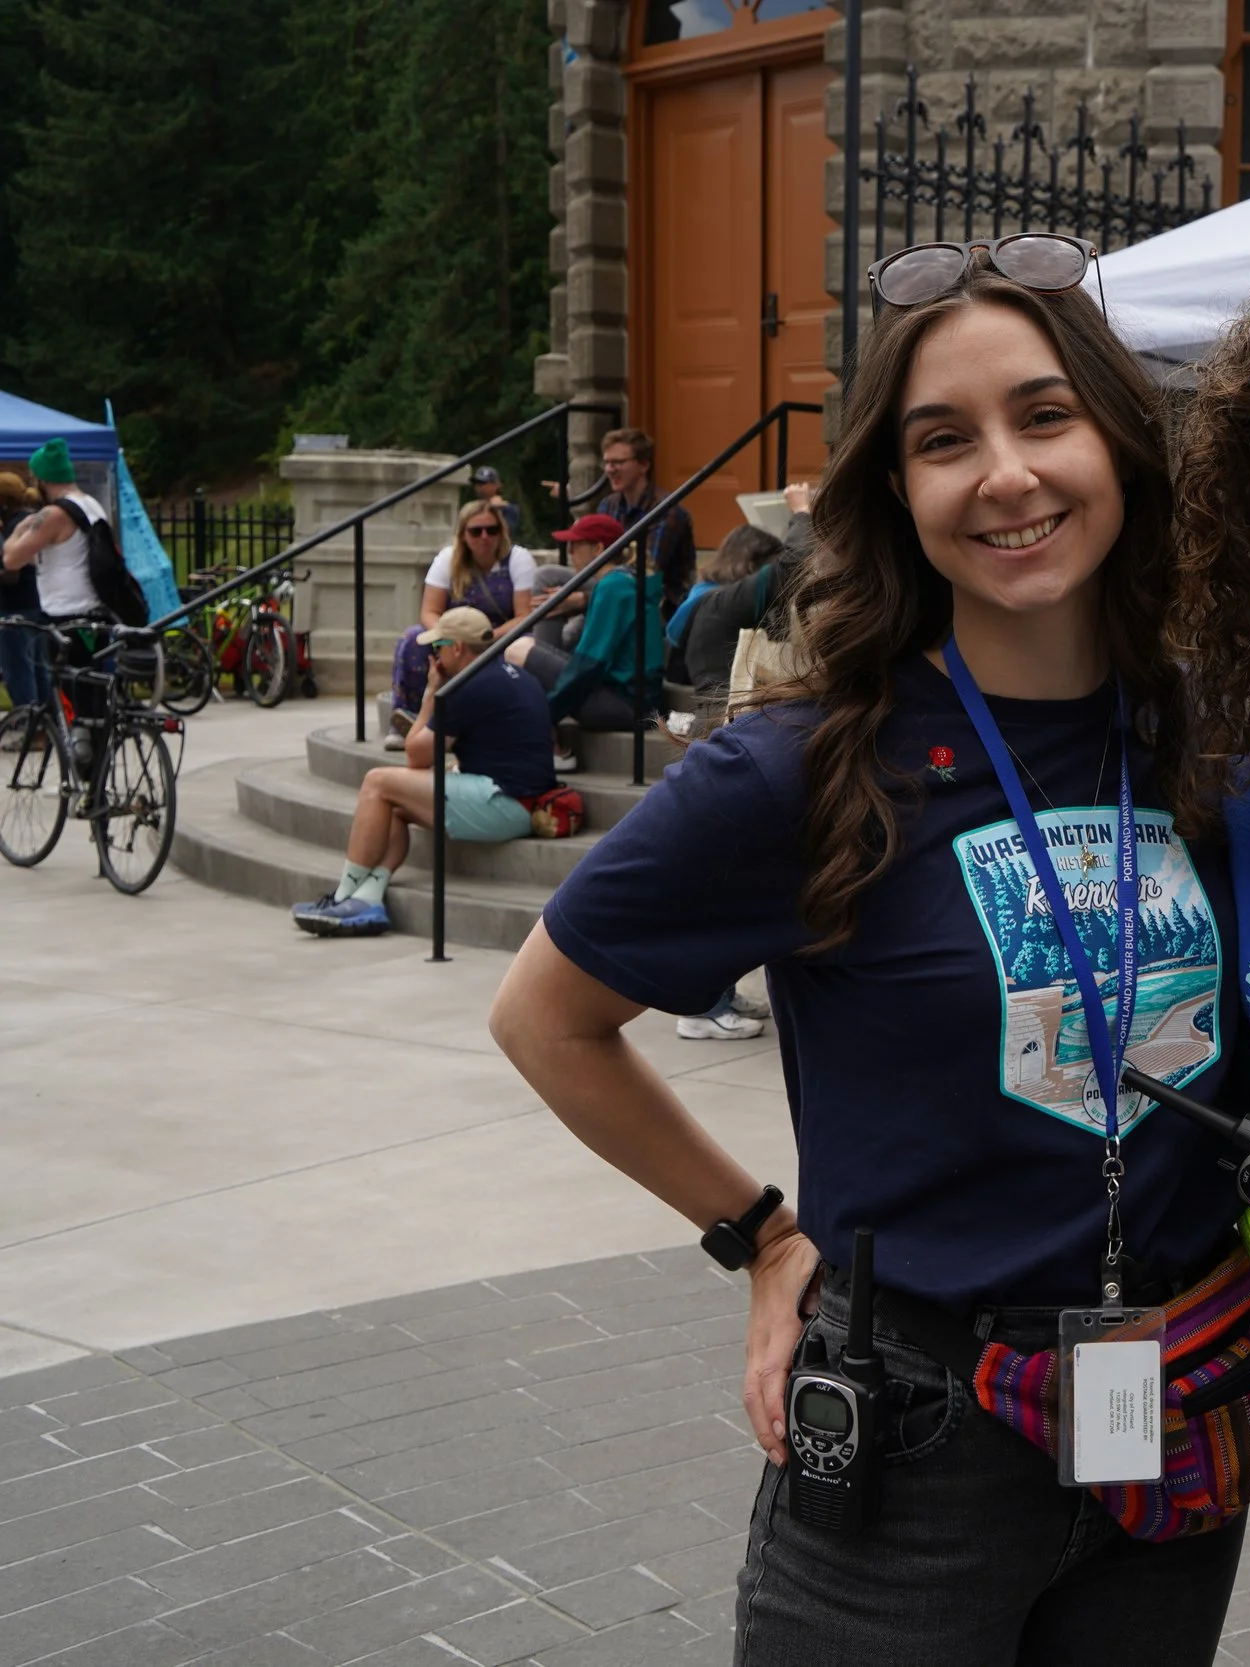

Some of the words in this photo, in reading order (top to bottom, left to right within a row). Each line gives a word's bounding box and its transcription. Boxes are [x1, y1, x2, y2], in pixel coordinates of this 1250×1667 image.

[1121, 794, 1131, 827] WATER
[970, 823, 1113, 866] WASINGTON
[1120, 823, 1170, 845] ARK
[1056, 853, 1112, 872] HISTIC
[1122, 827, 1133, 882] PORTLAND
[1124, 908, 1134, 950] BUREAU
[1124, 951, 1134, 987] WATER
[1119, 988, 1132, 1046] PORTLAND
[816, 1383, 831, 1392] GXT
[801, 1468, 839, 1485] MIDLAND
